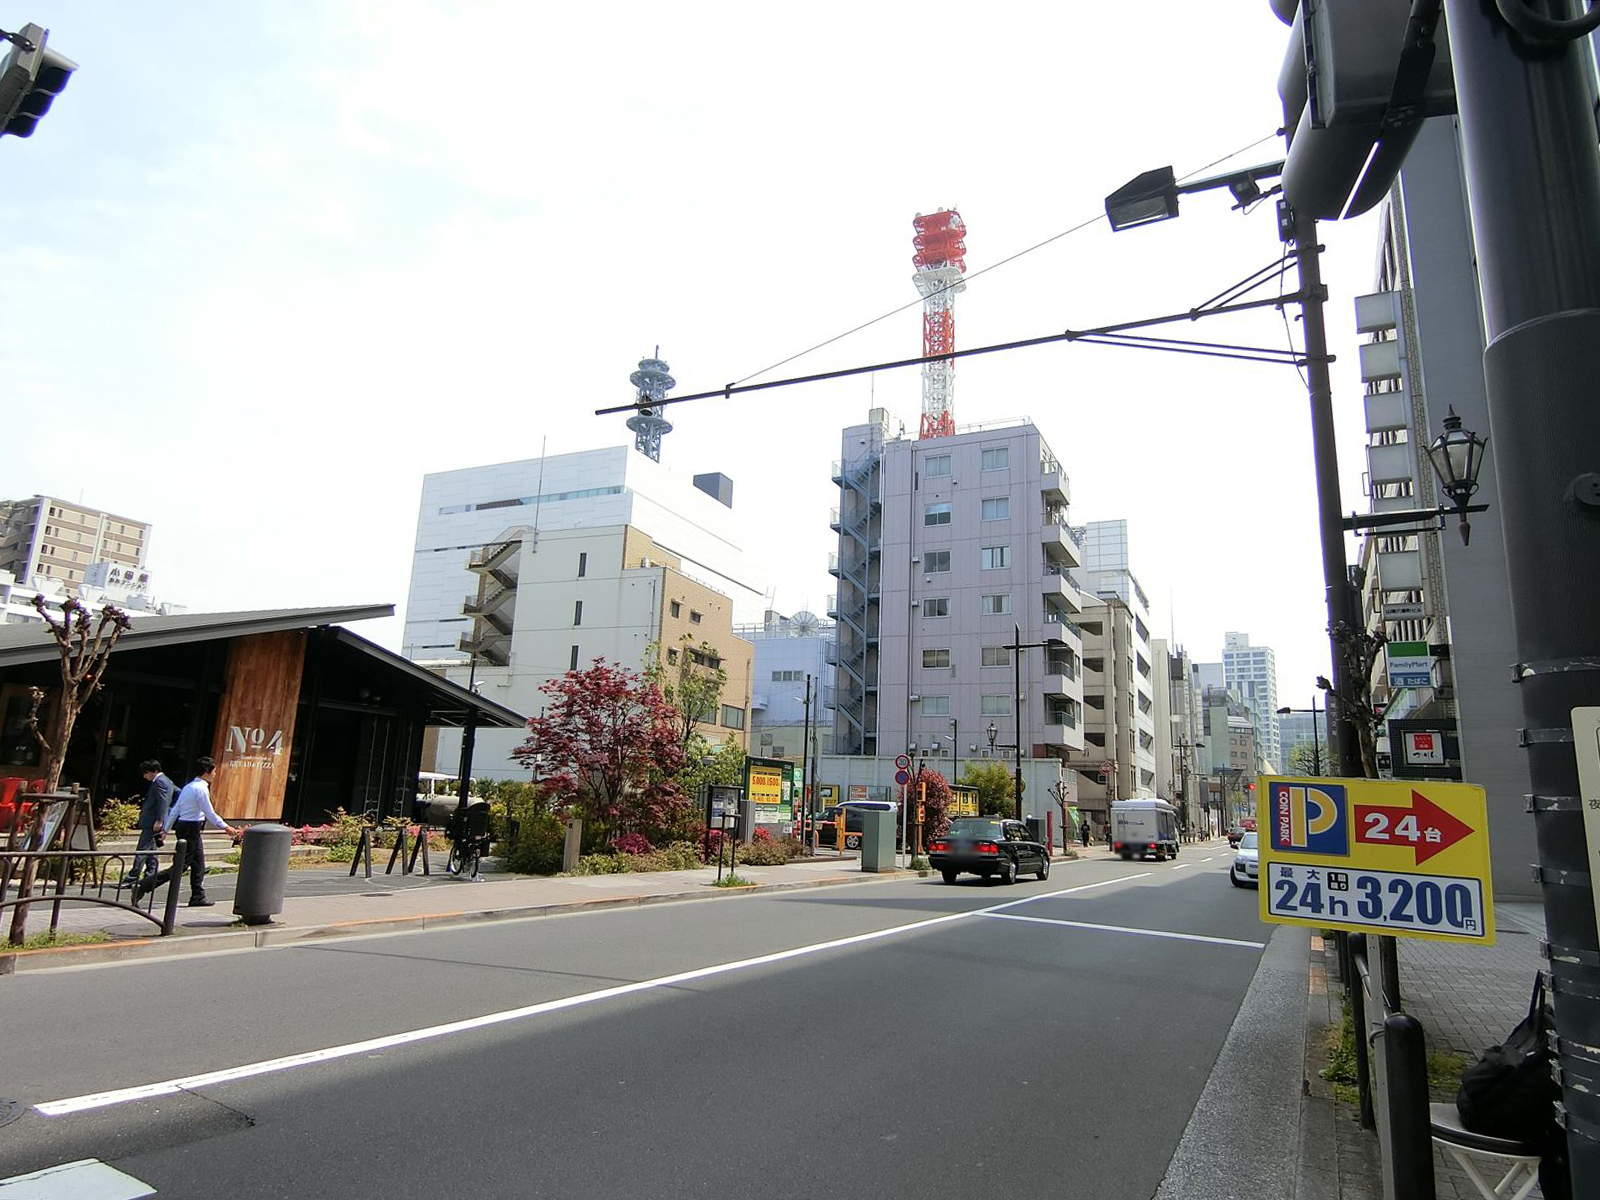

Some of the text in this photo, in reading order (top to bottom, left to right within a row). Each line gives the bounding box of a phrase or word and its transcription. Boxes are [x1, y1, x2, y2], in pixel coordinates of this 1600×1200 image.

[1389, 661, 1428, 669] FamilyMart
[1407, 677, 1429, 685] たばこ
[1279, 791, 1290, 842] COIN PARK
[1280, 866, 1320, 880] 最大
